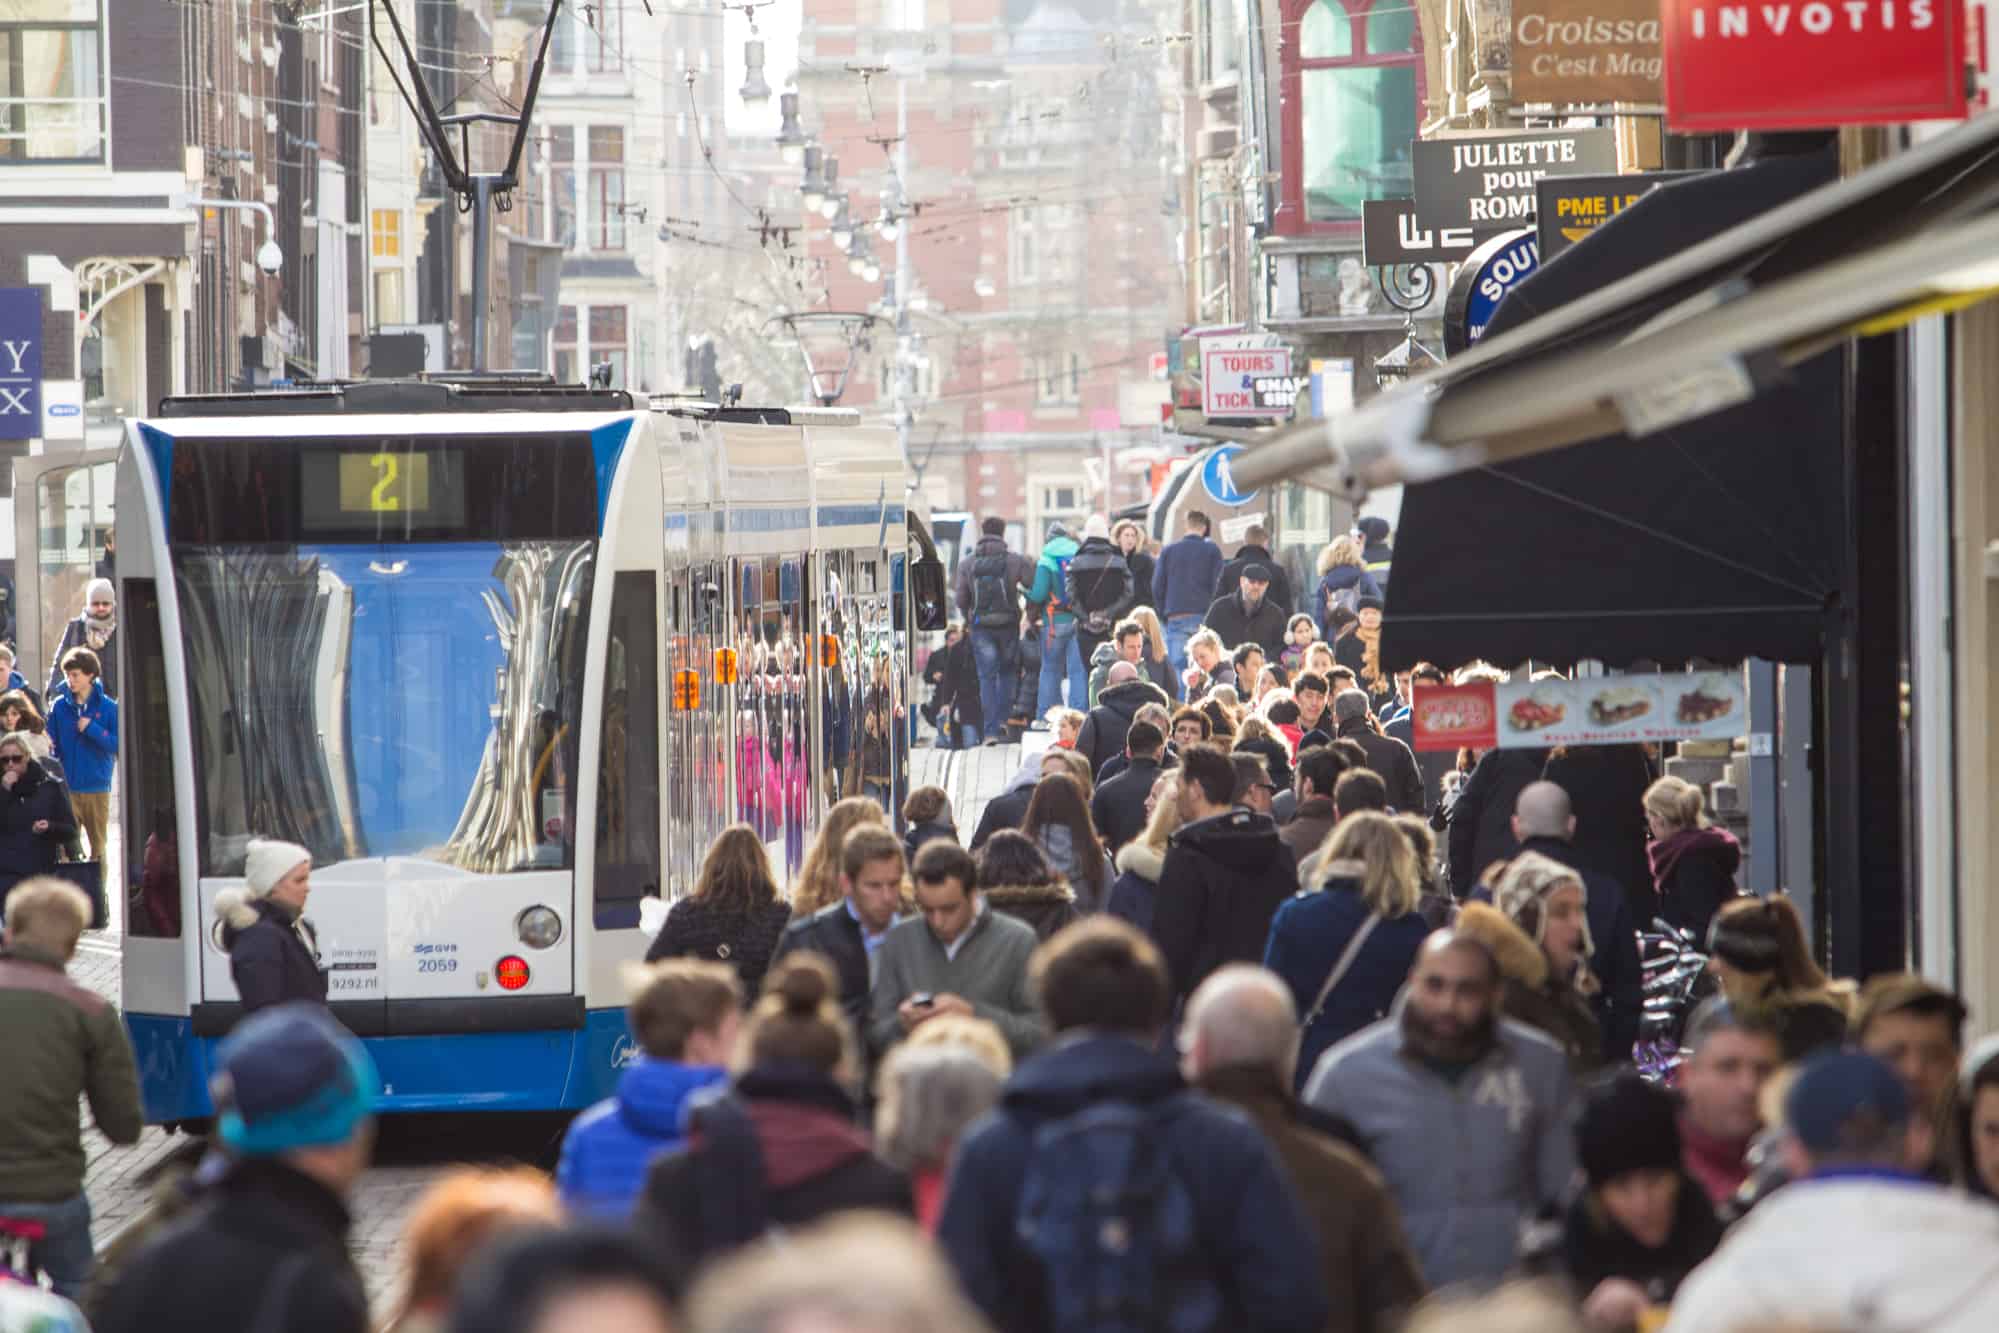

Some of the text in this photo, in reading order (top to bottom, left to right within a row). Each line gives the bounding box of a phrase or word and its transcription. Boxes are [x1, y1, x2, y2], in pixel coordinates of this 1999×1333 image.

[1692, 0, 1934, 39] INVOTIS
[1532, 54, 1597, 78] C'est
[1453, 139, 1576, 173] JULIETTE
[1483, 169, 1547, 196] pour
[1557, 197, 1606, 217] PME
[1221, 356, 1275, 372] TOURS
[1241, 375, 1252, 389] &
[370, 454, 399, 511] 2
[418, 959, 457, 973] 2059
